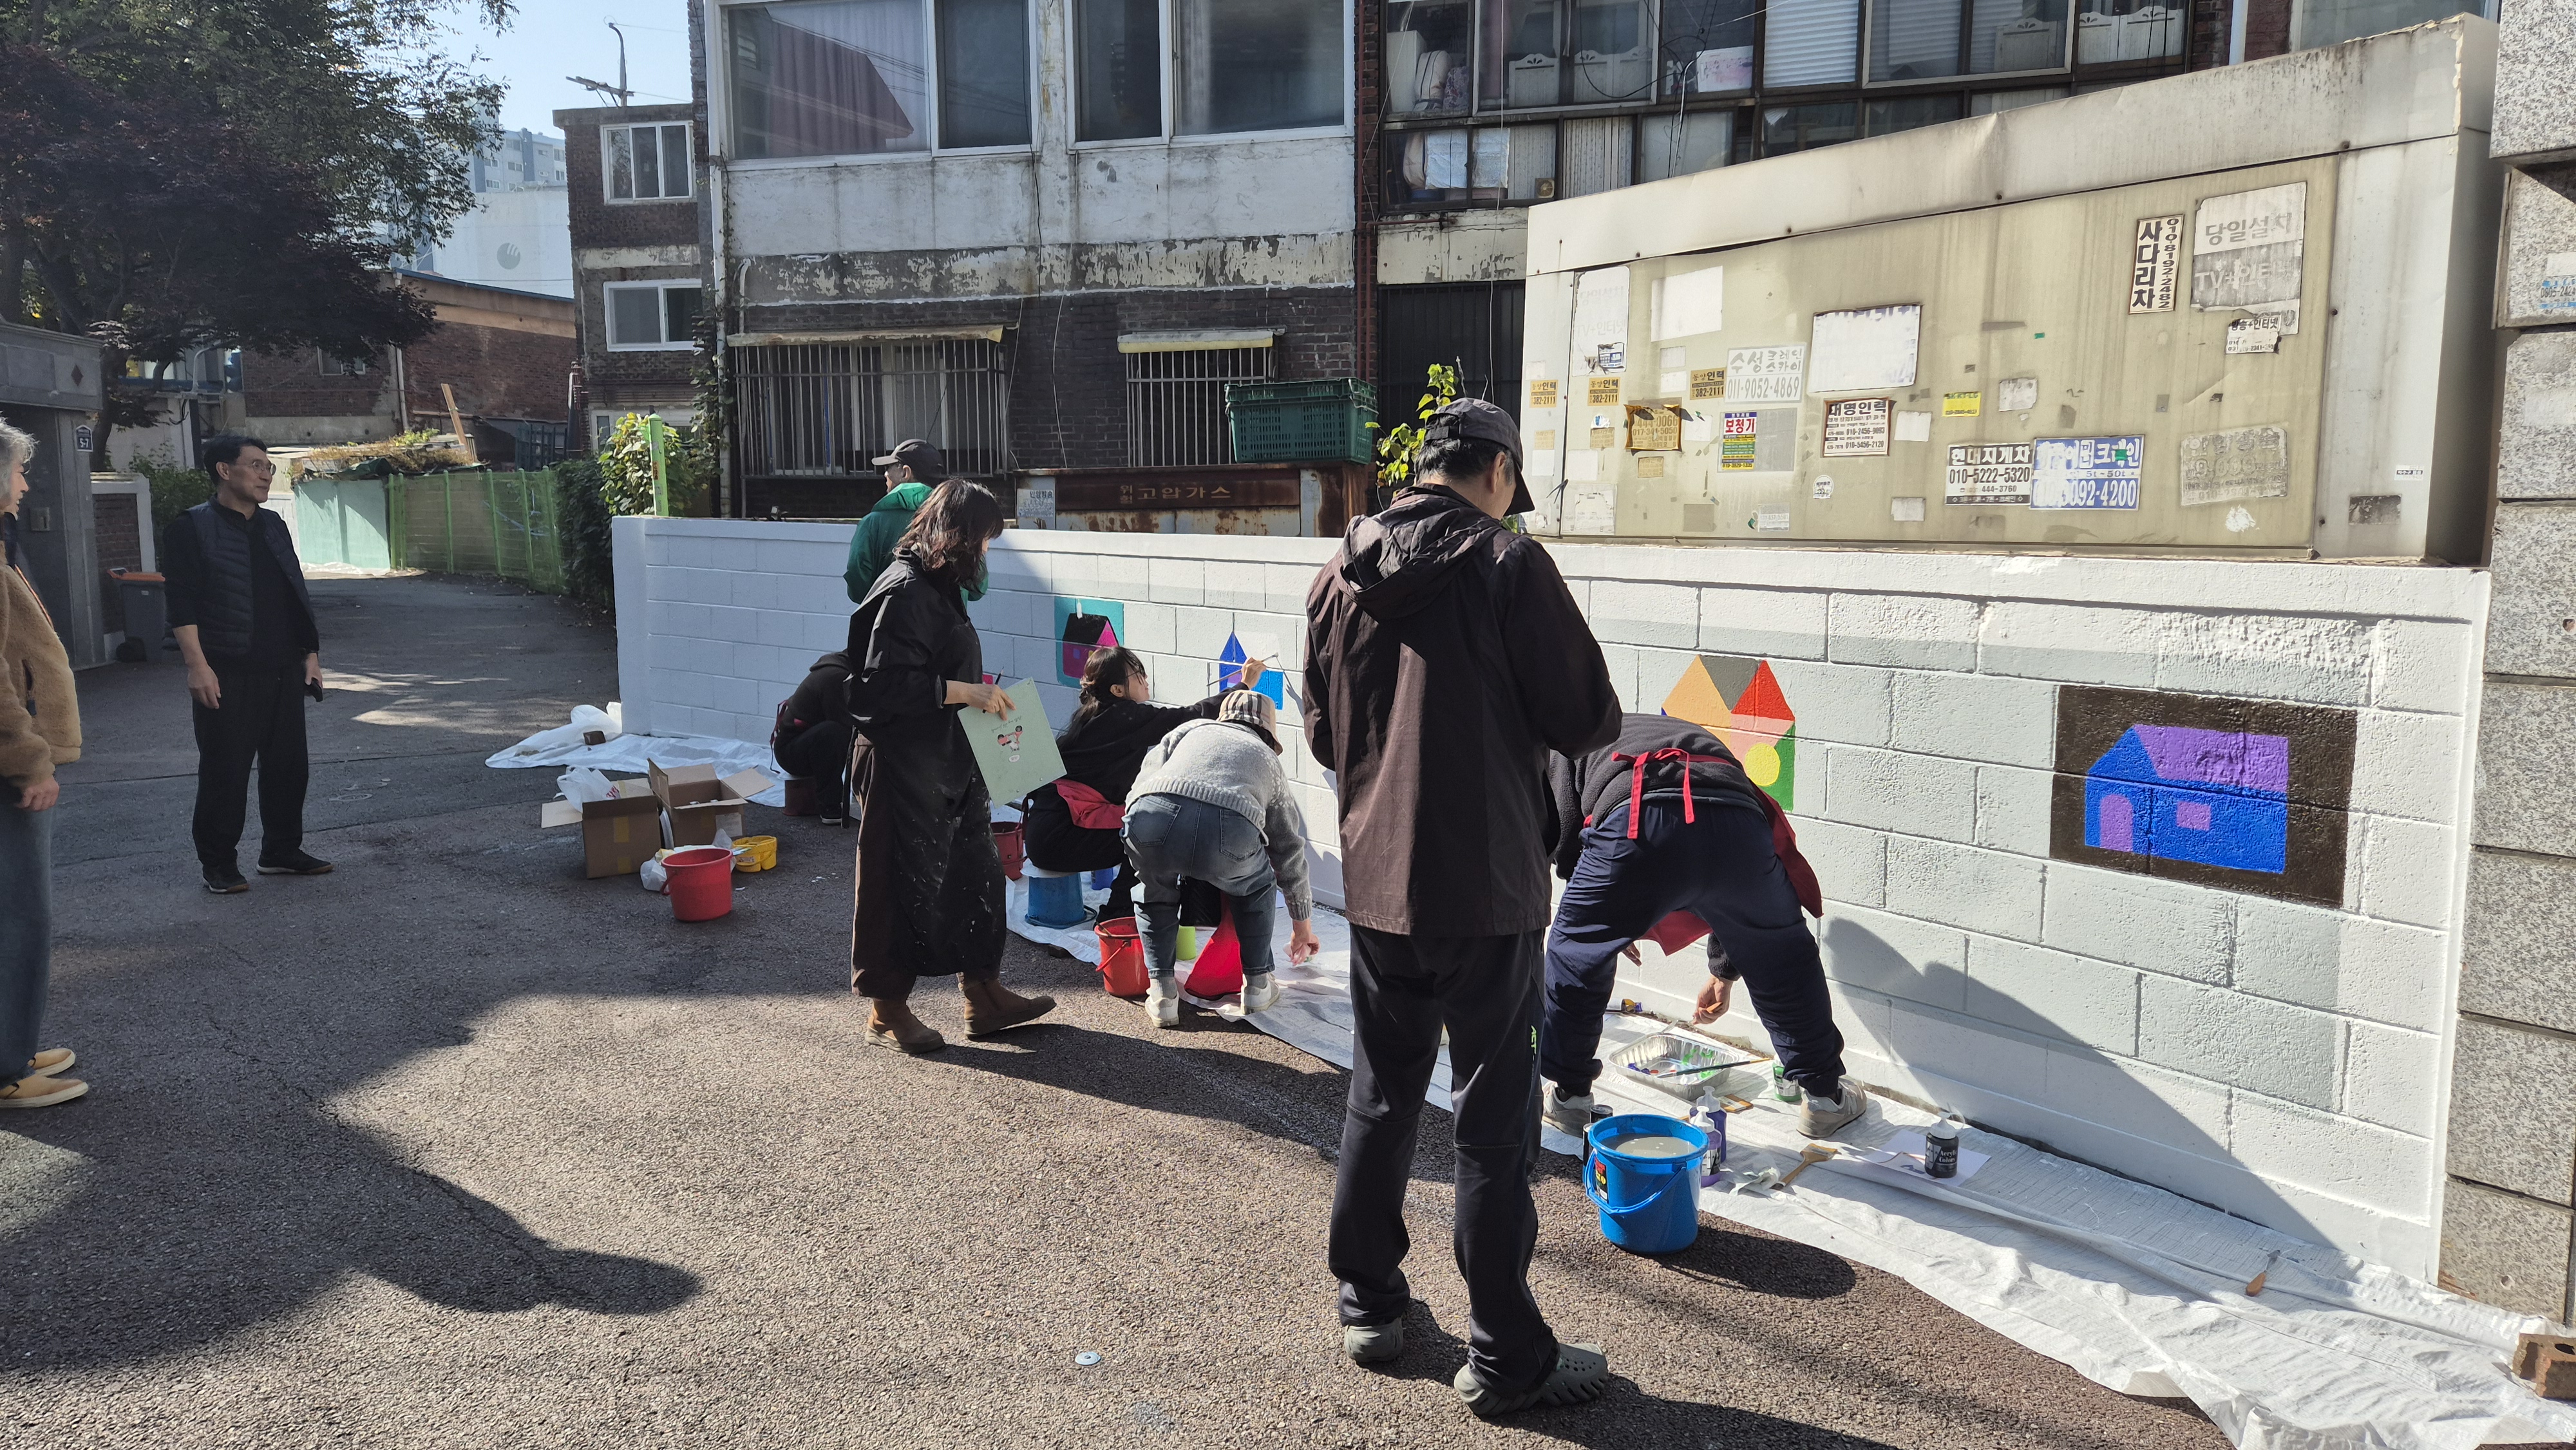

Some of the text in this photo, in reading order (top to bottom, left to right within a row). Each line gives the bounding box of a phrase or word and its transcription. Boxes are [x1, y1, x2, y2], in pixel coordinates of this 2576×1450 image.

[2132, 221, 2163, 308] 사다리차
[1730, 348, 1802, 373] 수성 크레인
[1766, 361, 1801, 372] 스카이
[1592, 394, 1618, 403] 382-2111
[1695, 386, 1724, 397] 382-2111
[1533, 396, 1555, 404] 382-2111
[1829, 401, 1886, 416] 대명인력
[1725, 419, 1755, 433] 보청기
[1951, 446, 2030, 465] 현대지게차
[1949, 467, 2030, 484] 010-5222-5320
[1138, 486, 1231, 500] 고압가스
